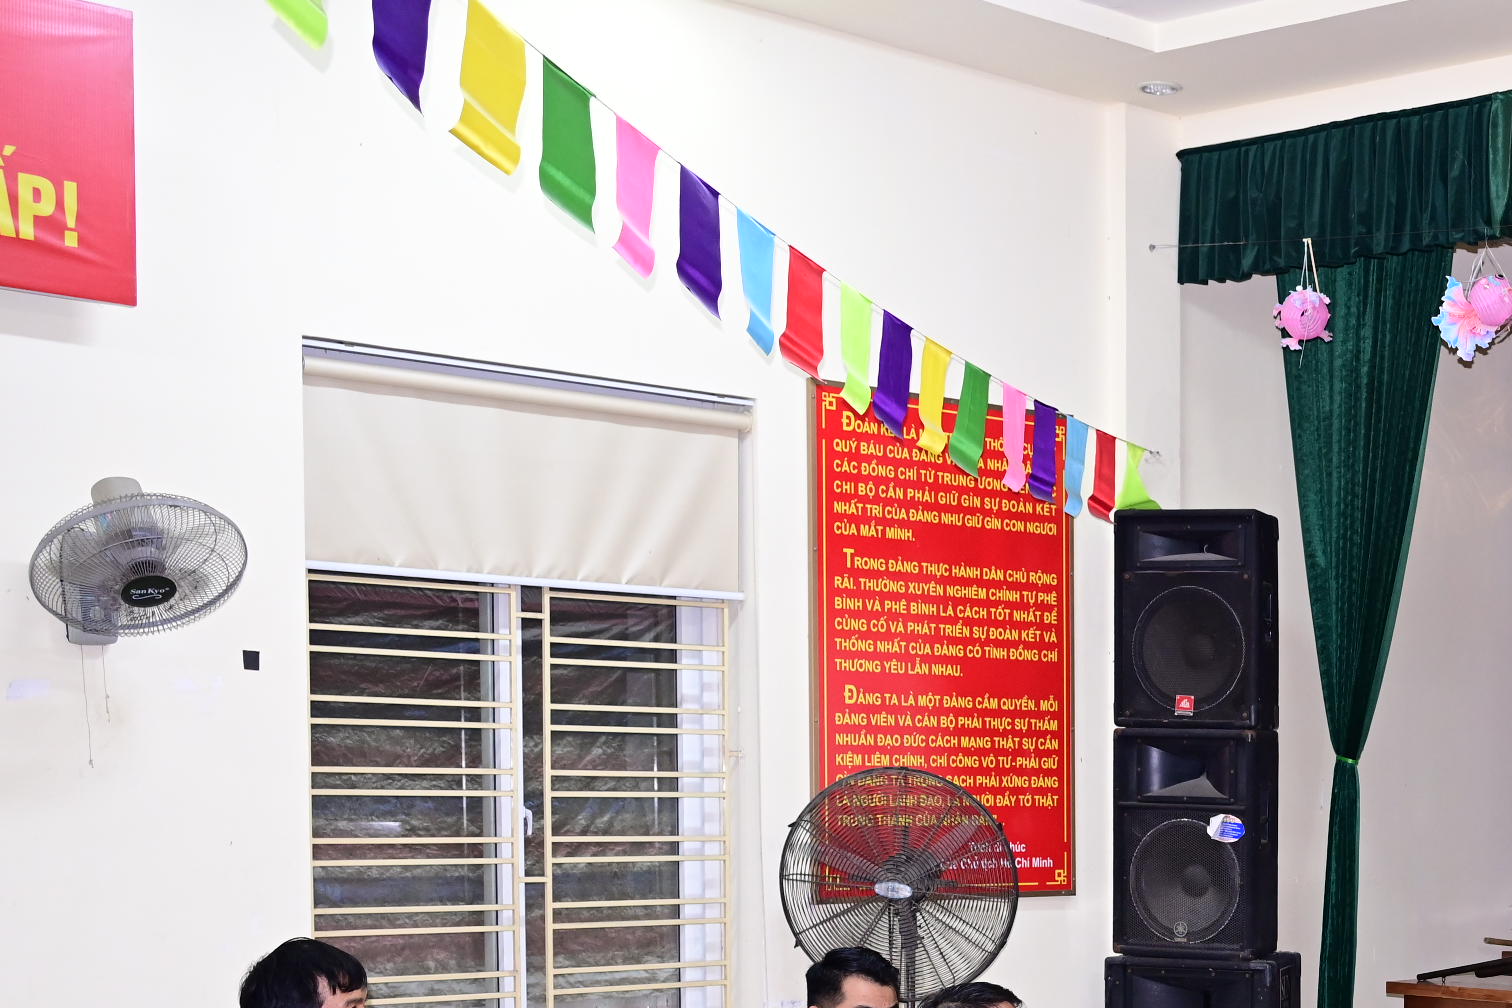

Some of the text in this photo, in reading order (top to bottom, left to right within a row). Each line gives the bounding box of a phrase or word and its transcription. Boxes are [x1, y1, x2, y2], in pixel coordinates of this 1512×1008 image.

[841, 410, 878, 435] ĐOÀN
[833, 438, 910, 460] QUÝ BÁU CỦA
[833, 457, 858, 473] CÁC
[860, 458, 894, 478] ĐỒNG
[897, 465, 917, 480] CHÍ
[919, 467, 935, 482] TỪ
[937, 471, 975, 488] TRUNG
[833, 479, 854, 494] CHI
[857, 480, 875, 499] BỘ
[907, 486, 934, 502] PHẢI
[937, 490, 958, 505] GIỮ
[960, 492, 980, 508] GÌN
[983, 497, 999, 512] SỰ
[1001, 497, 1032, 513] ĐOÀN
[833, 498, 863, 515] NHẤT
[864, 503, 882, 517] TRÍ
[884, 503, 907, 520] CỦA
[908, 505, 939, 523] ĐẢNG
[940, 512, 963, 525] NHƯ
[964, 513, 982, 527] GIỮ
[983, 514, 1001, 529] GÌN
[1003, 518, 1024, 532] CON
[833, 518, 915, 541] CỦA MẮT MÌNH.
[843, 547, 1057, 586] TRONG ĐẢNG THỰC HÀNH DÂN CHỦ RỘNG
[858, 576, 905, 593] THƯỜNG
[907, 580, 943, 596] XUYÊN
[946, 584, 986, 599] NGHIÊM
[988, 585, 1019, 601] CHỈNH
[1021, 590, 1036, 605] TỰ
[1037, 590, 1057, 604] PHÊ
[834, 595, 1057, 624] BÌNH VÀ PHÊ BÌNH LÀ CÁCH TỐT NHẤT ĐỂ
[834, 613, 1057, 642] CỦNG CỐ VÀ PHÁT TRIỂN SỰ ĐOÀN KẾT VÀ
[833, 634, 1057, 661] THỐNG NHẤT CỦA ĐẢNG CÓ TÌNH ĐỒNG CHÍ
[834, 657, 962, 676] THƯƠNG YÊU LẪN NHAU.
[843, 683, 881, 705] ĐẢNG
[883, 693, 898, 705] TA
[901, 692, 915, 706] LÀ
[917, 691, 940, 709] MỘT
[942, 691, 972, 708] ĐẢNG
[834, 708, 867, 725] ĐẢNG
[869, 711, 895, 726] VIÊN
[897, 711, 912, 726] VÀ
[914, 712, 937, 727] CÁN
[939, 713, 955, 730] BỘ
[957, 713, 982, 728] PHẢI
[983, 716, 1011, 732] THỰC
[1014, 717, 1028, 732] SỰ
[876, 733, 901, 749] ĐẠO
[902, 732, 926, 747] ĐỨC
[928, 732, 957, 747] CÁCH
[960, 735, 991, 750] MẠNG
[993, 734, 1019, 751] THẬT
[1022, 736, 1036, 752] SỰ
[835, 750, 862, 768] KIỆM
[864, 751, 889, 767] LIÊM
[929, 752, 947, 767] CHÍ
[949, 752, 979, 767] CÔNG
[981, 753, 995, 767] VÔ
[1040, 754, 1058, 768] GIỮ
[976, 772, 999, 788] PHẢI
[1001, 774, 1029, 788] XỨNG
[1031, 773, 1059, 788] ĐÁNG
[1019, 791, 1032, 807] TỚ
[1034, 793, 1059, 809] THẬT
[1014, 857, 1030, 868] Chí
[1032, 857, 1053, 868] Minh
